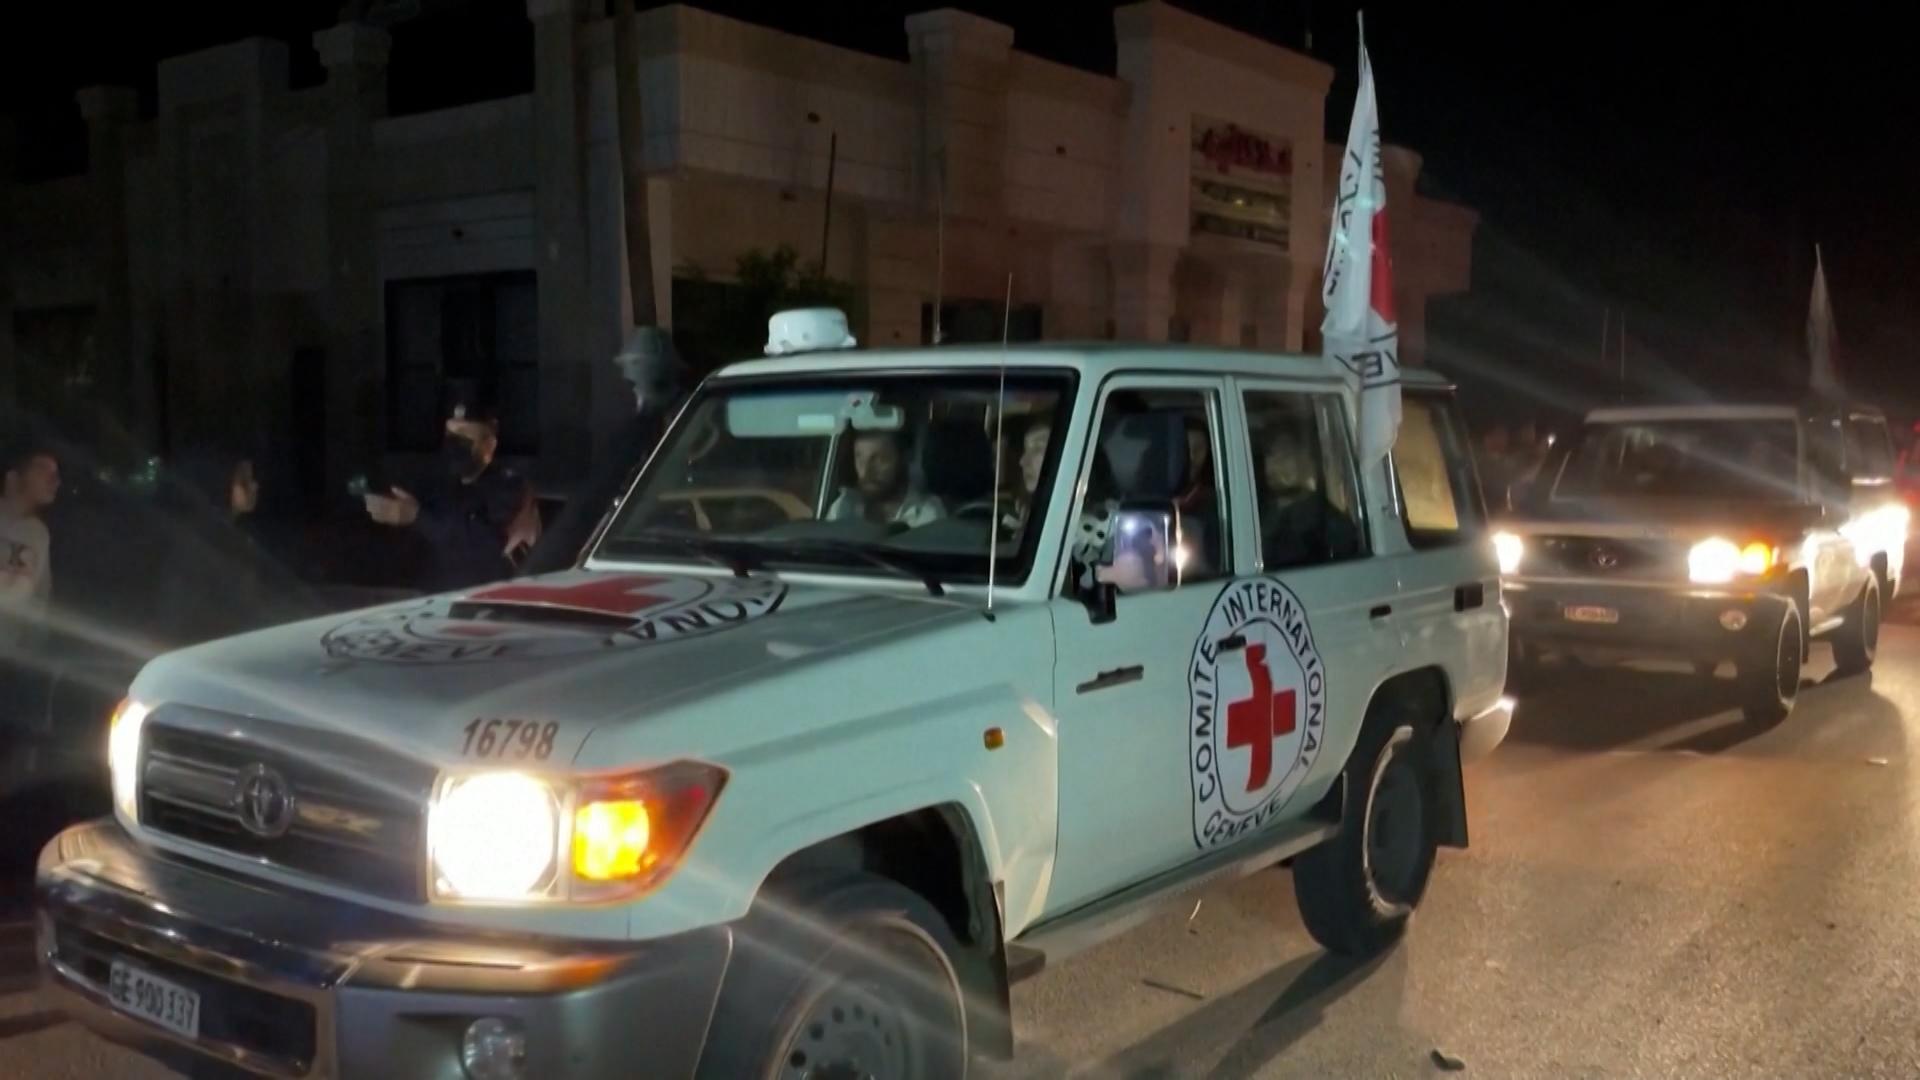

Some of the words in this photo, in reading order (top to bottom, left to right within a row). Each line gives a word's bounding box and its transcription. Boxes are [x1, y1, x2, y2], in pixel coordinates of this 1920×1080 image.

[462, 717, 560, 760] 16798
[1194, 635, 1217, 803] COMITE
[1203, 798, 1281, 845] GENEVE
[112, 969, 131, 1004] GE
[135, 977, 164, 1018] 900
